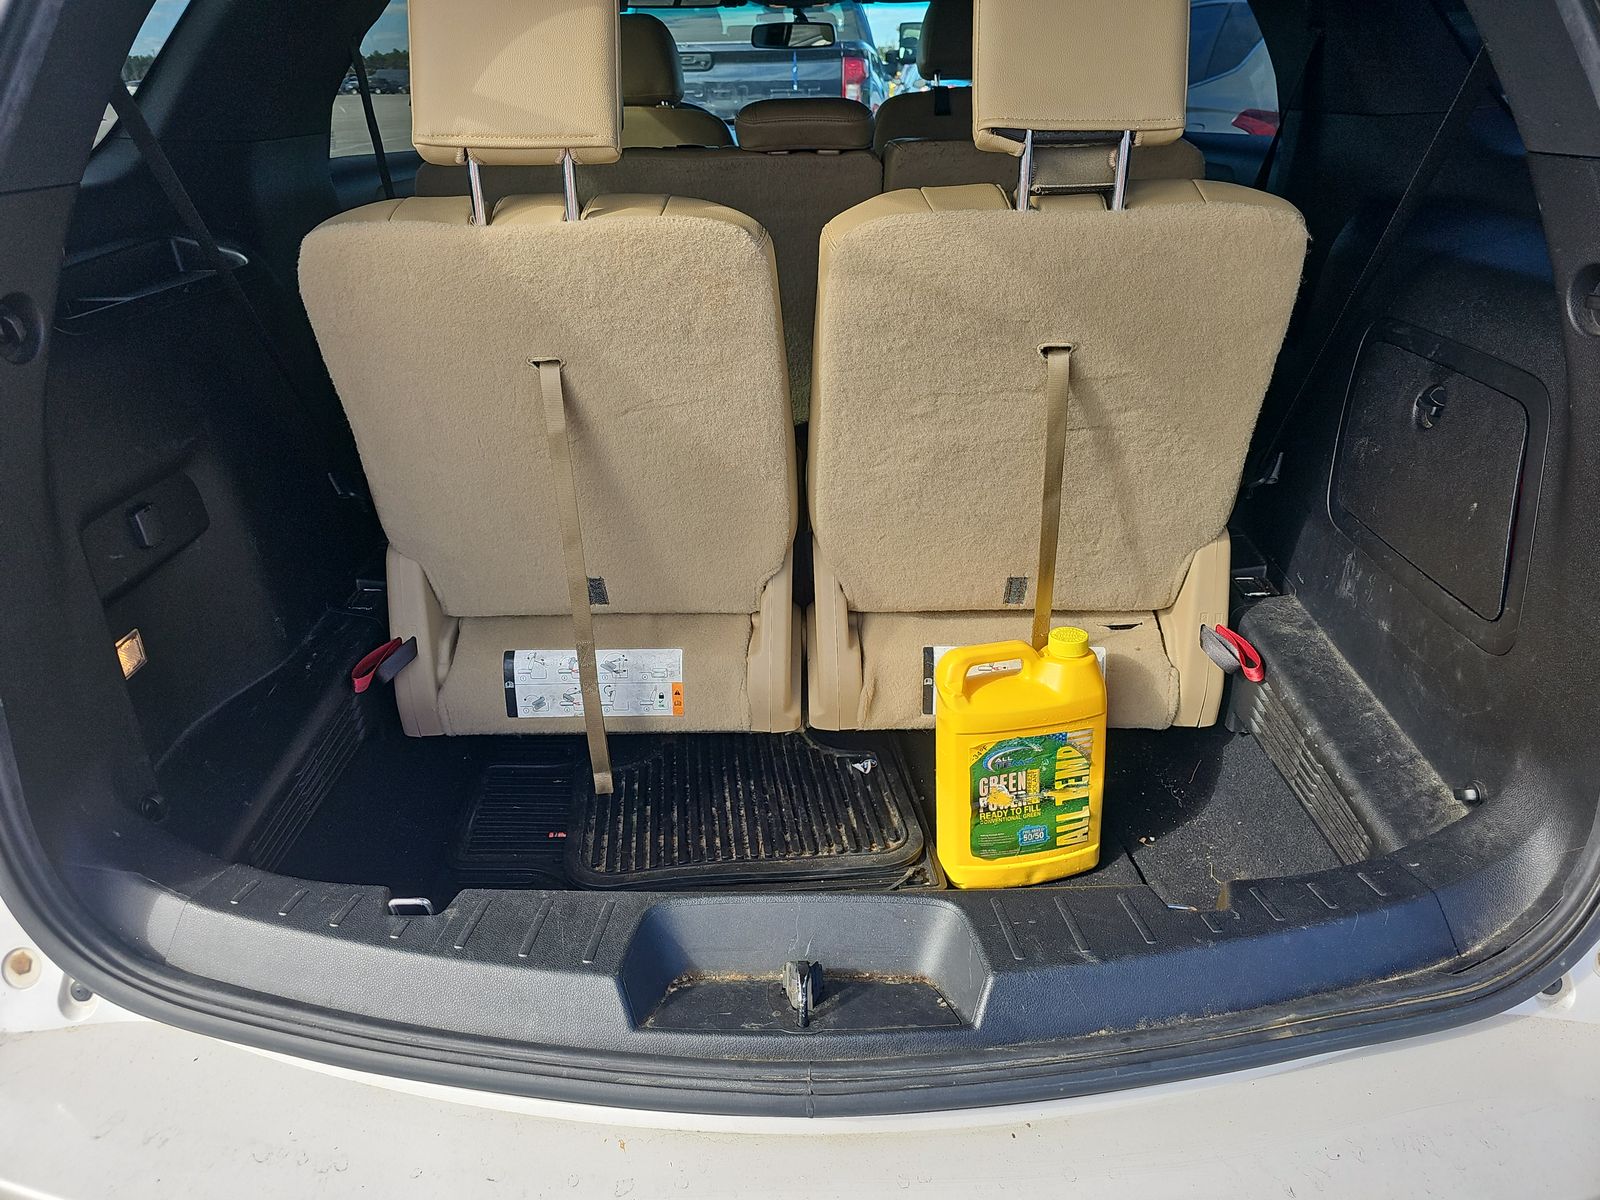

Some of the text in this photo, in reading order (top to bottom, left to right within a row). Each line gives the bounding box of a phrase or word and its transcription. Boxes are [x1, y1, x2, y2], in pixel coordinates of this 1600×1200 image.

[979, 770, 1027, 797] GREEN
[1055, 745, 1090, 846] ALL TEMP
[979, 804, 1041, 821] READY TO FILL
[979, 811, 1041, 825] CONVENTIONAL GREEN
[1023, 832, 1045, 842] 50/50
